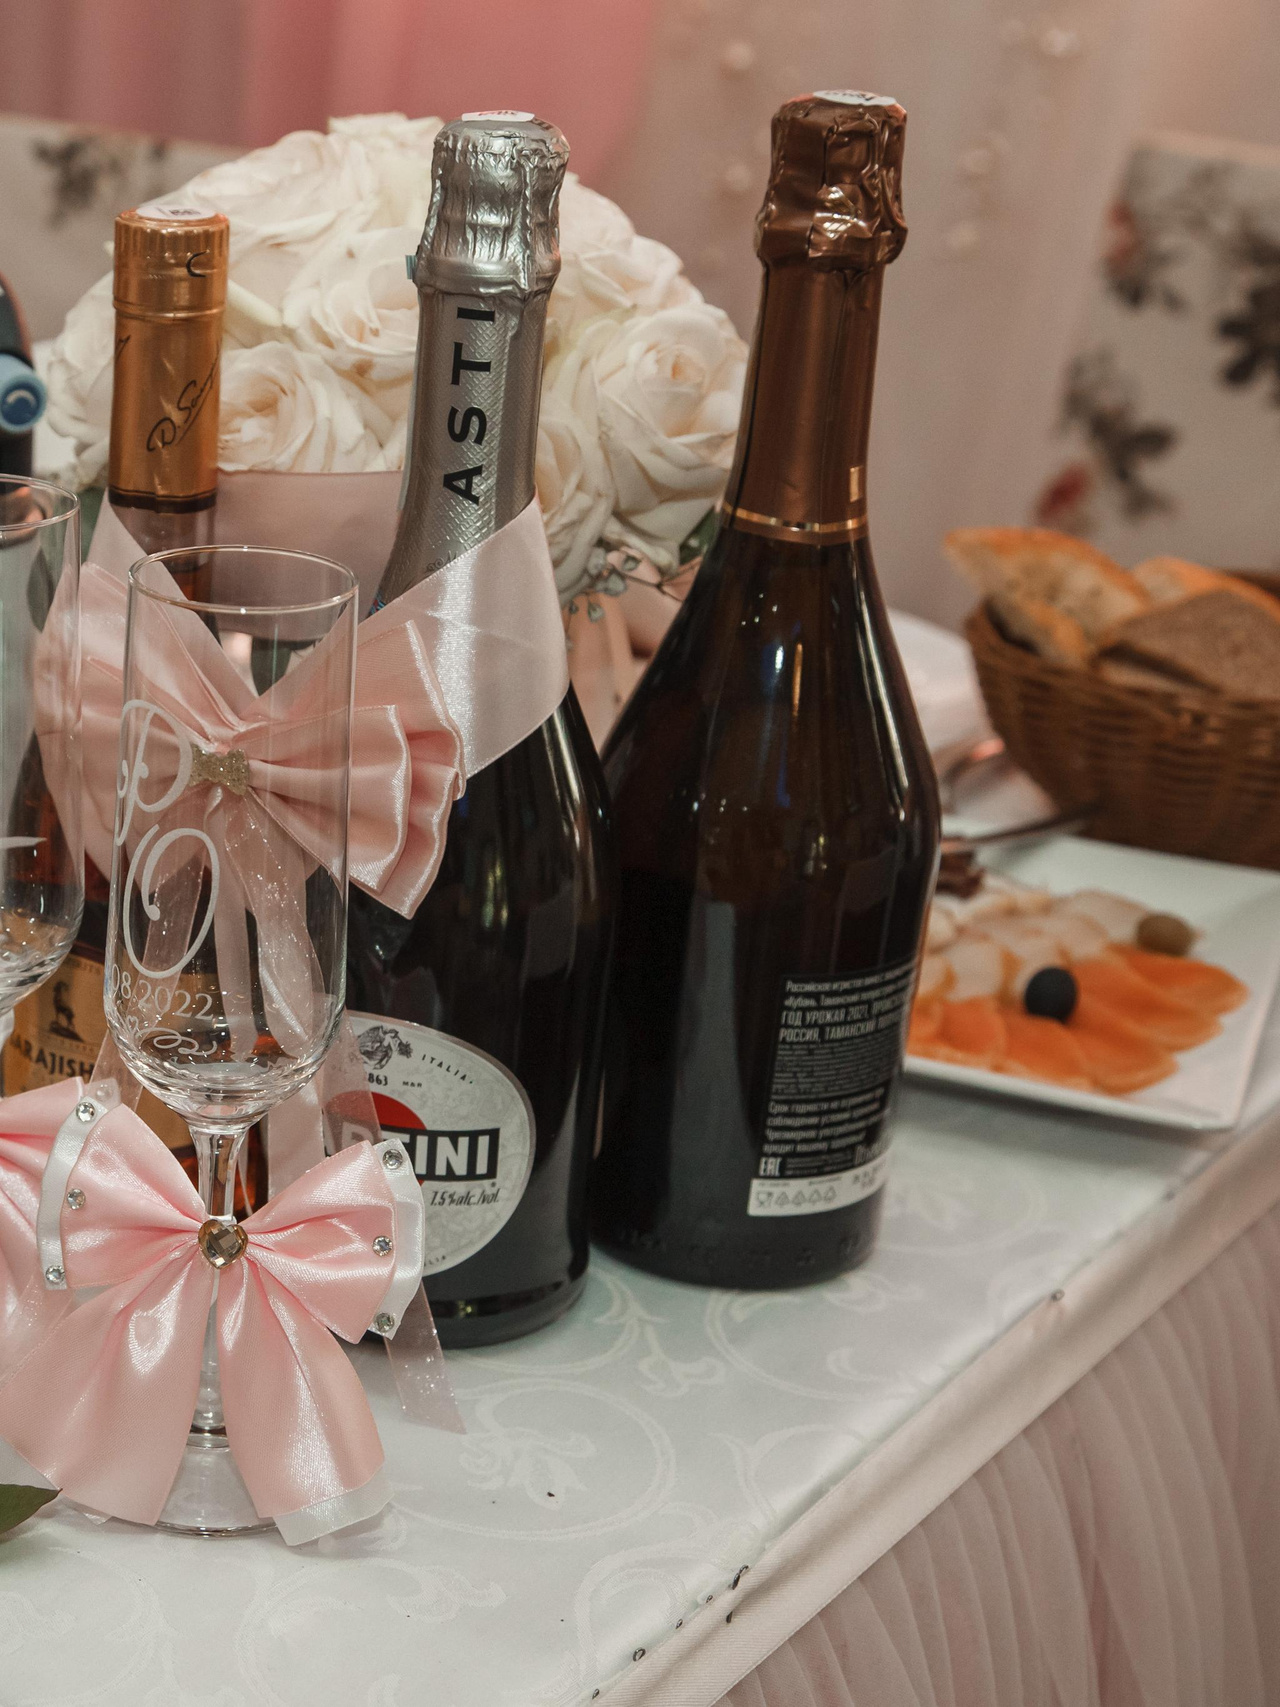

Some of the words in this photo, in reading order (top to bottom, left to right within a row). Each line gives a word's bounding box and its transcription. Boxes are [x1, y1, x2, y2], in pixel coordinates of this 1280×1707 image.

[442, 306, 496, 506] ASTI
[781, 1009, 803, 1026] ГОД
[365, 1072, 389, 1087] 863
